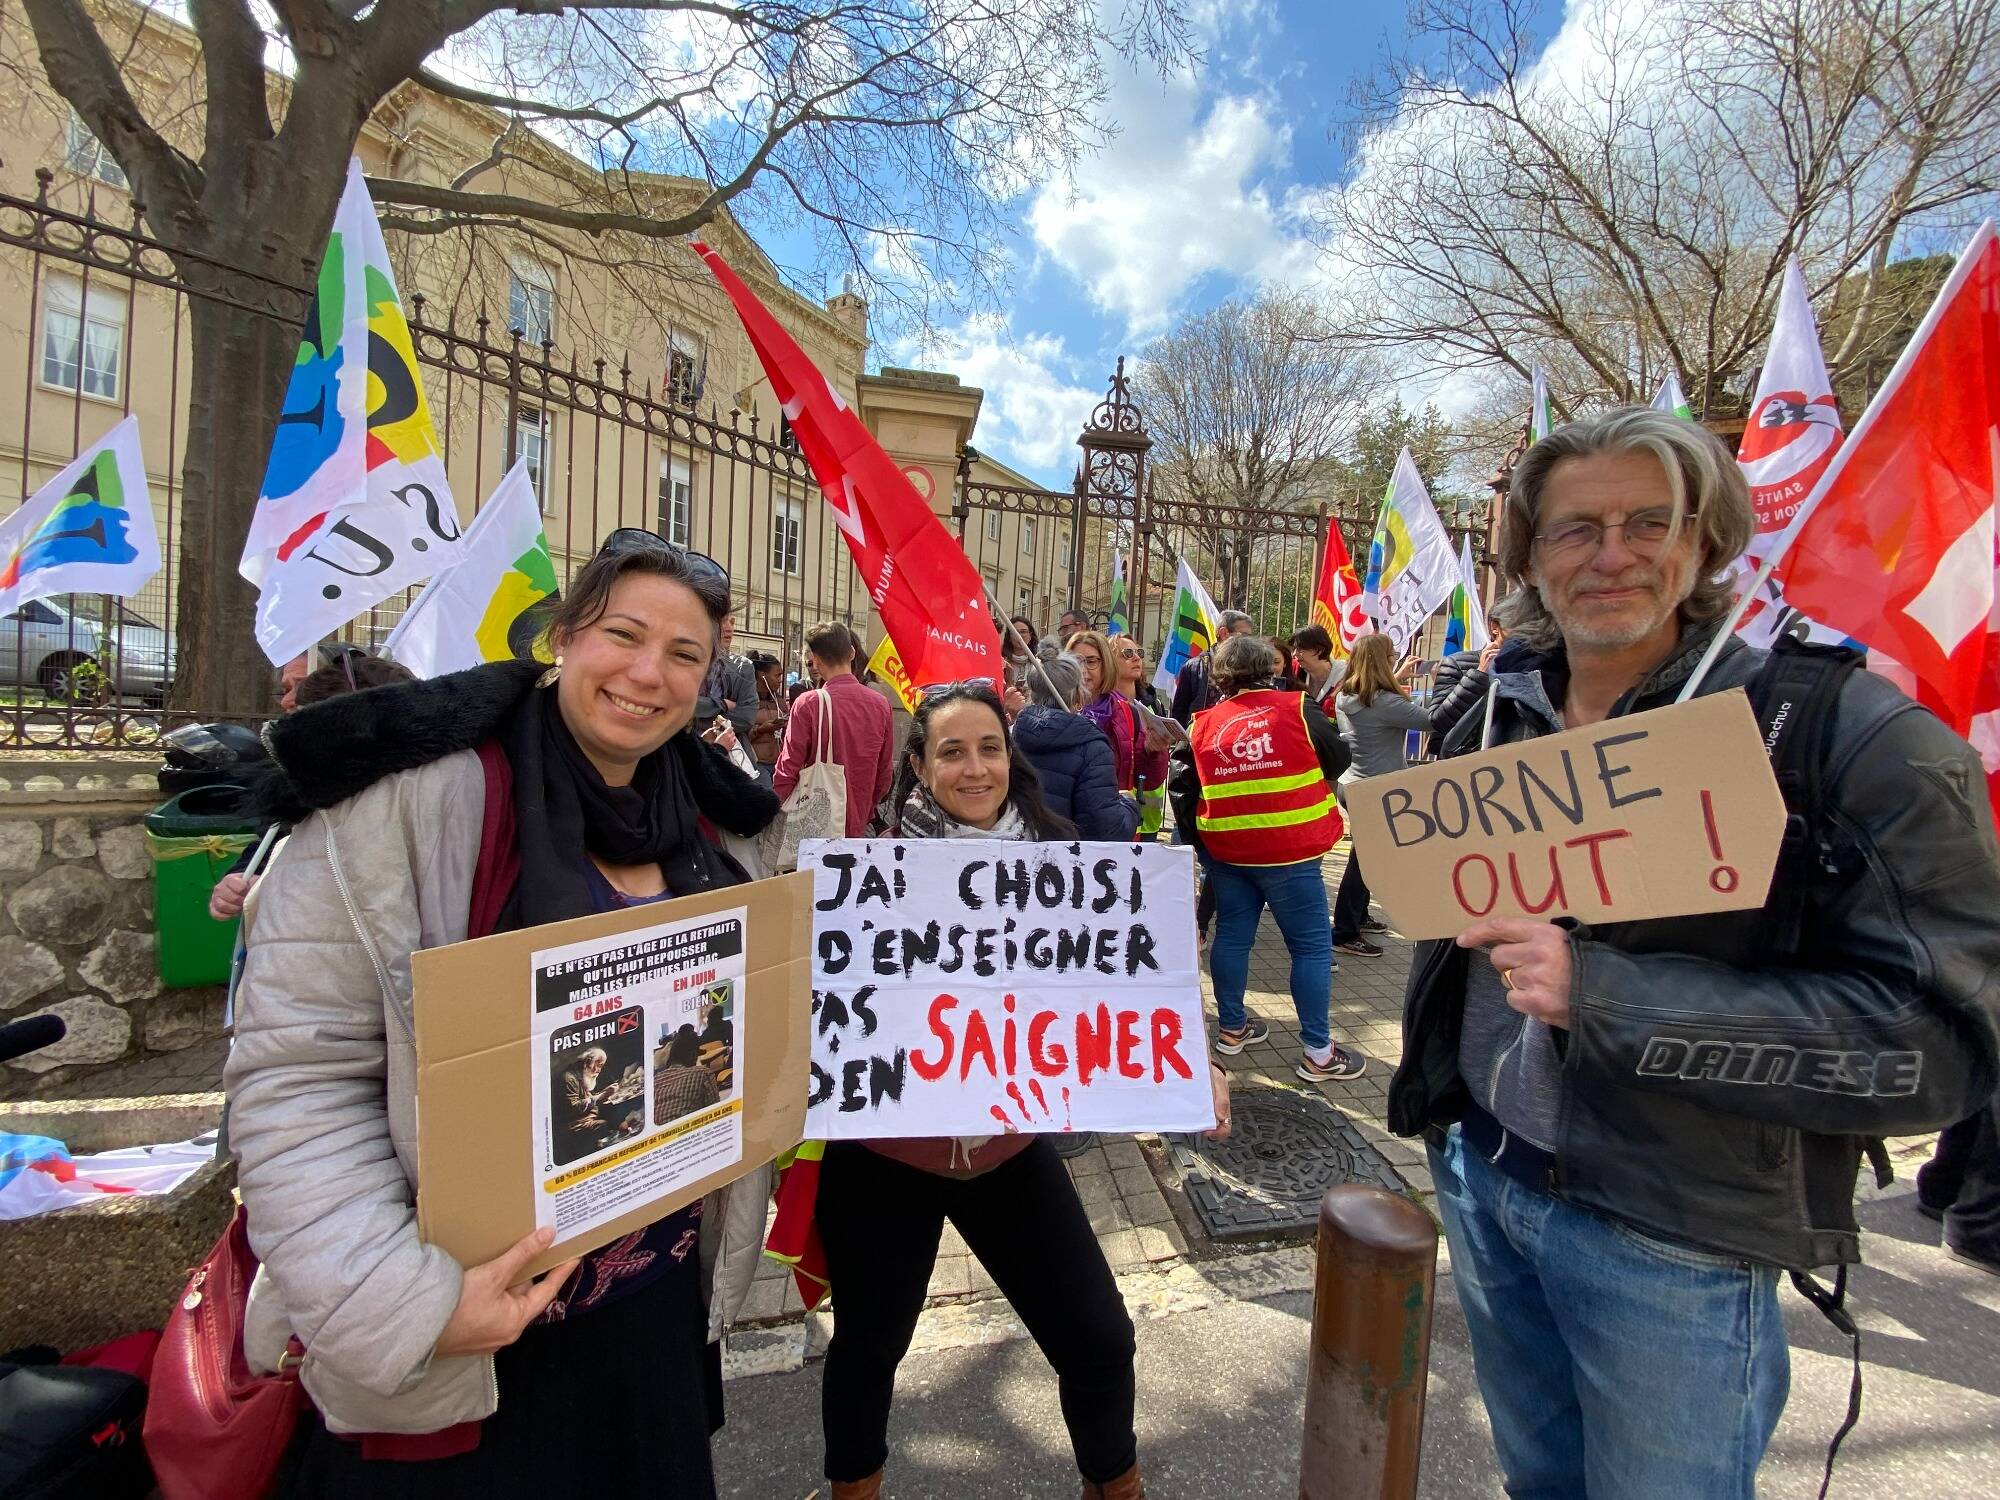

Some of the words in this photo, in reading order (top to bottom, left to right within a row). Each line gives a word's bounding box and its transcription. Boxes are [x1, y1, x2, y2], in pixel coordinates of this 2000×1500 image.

[926, 623, 987, 656] ANÇAIS
[1231, 733, 1273, 761] cgt
[1214, 766, 1238, 776] Alpes
[1239, 760, 1283, 772] Maritimes
[1381, 731, 1662, 848] BORNE
[1451, 828, 1632, 918] OUT
[1699, 790, 1740, 894] !
[546, 963, 563, 978] CE
[565, 955, 599, 973] N'EST
[602, 949, 624, 964] PAS
[660, 937, 673, 949] DE
[675, 933, 688, 945] LA
[690, 921, 736, 939] RETRAITE
[583, 966, 613, 984] QU'IL
[616, 958, 644, 975] FAUT
[646, 942, 707, 967] REPOUSSER
[569, 984, 600, 1003] MAIS
[604, 978, 623, 993] LES
[673, 976, 688, 992] EN
[691, 969, 716, 987] JUIN
[573, 1004, 592, 1021] 64
[595, 995, 623, 1015] ANS
[682, 993, 709, 1012] BIEN
[553, 1032, 581, 1052] PAS
[584, 1021, 616, 1042] BIEN
[1636, 1037, 1923, 1097] DAINESE
